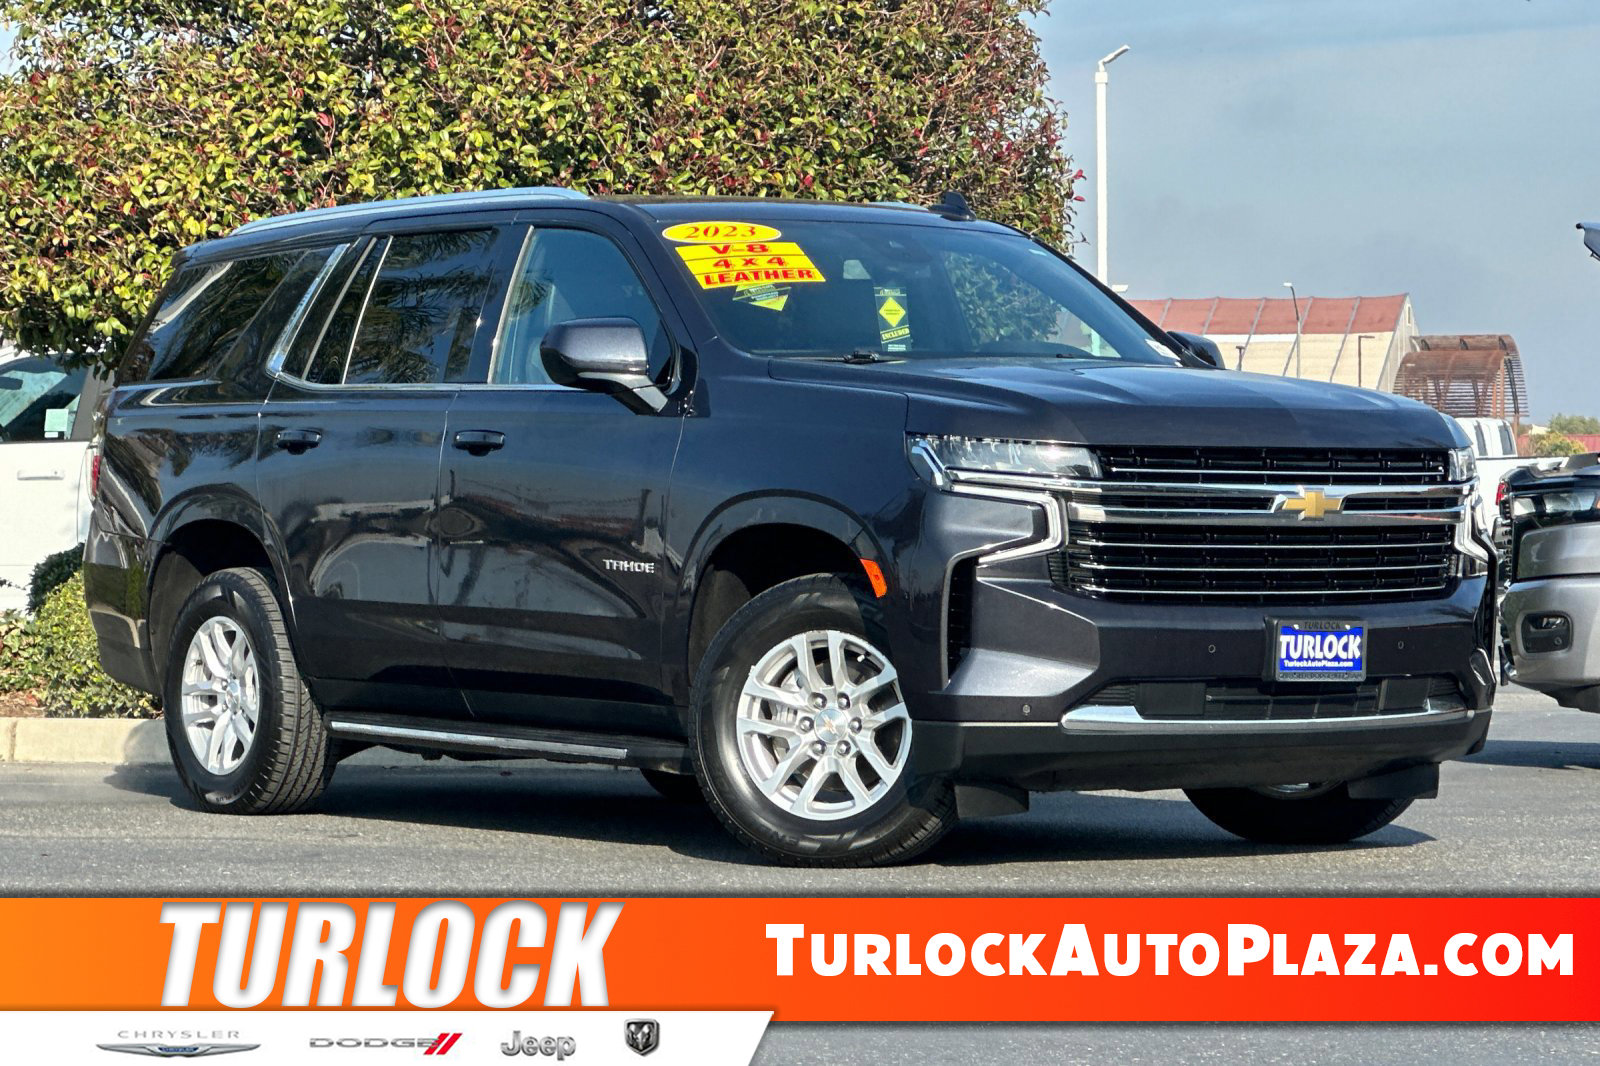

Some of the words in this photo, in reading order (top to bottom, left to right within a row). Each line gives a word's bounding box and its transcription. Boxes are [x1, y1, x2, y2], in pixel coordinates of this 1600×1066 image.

[685, 225, 756, 239] 2023
[704, 269, 814, 285] LEATHER
[602, 559, 655, 574] TAHOE
[1303, 621, 1341, 630] TURLOCK
[1280, 634, 1361, 660] TURLOCK
[1284, 660, 1354, 668] TurlockAutoPlaza.com
